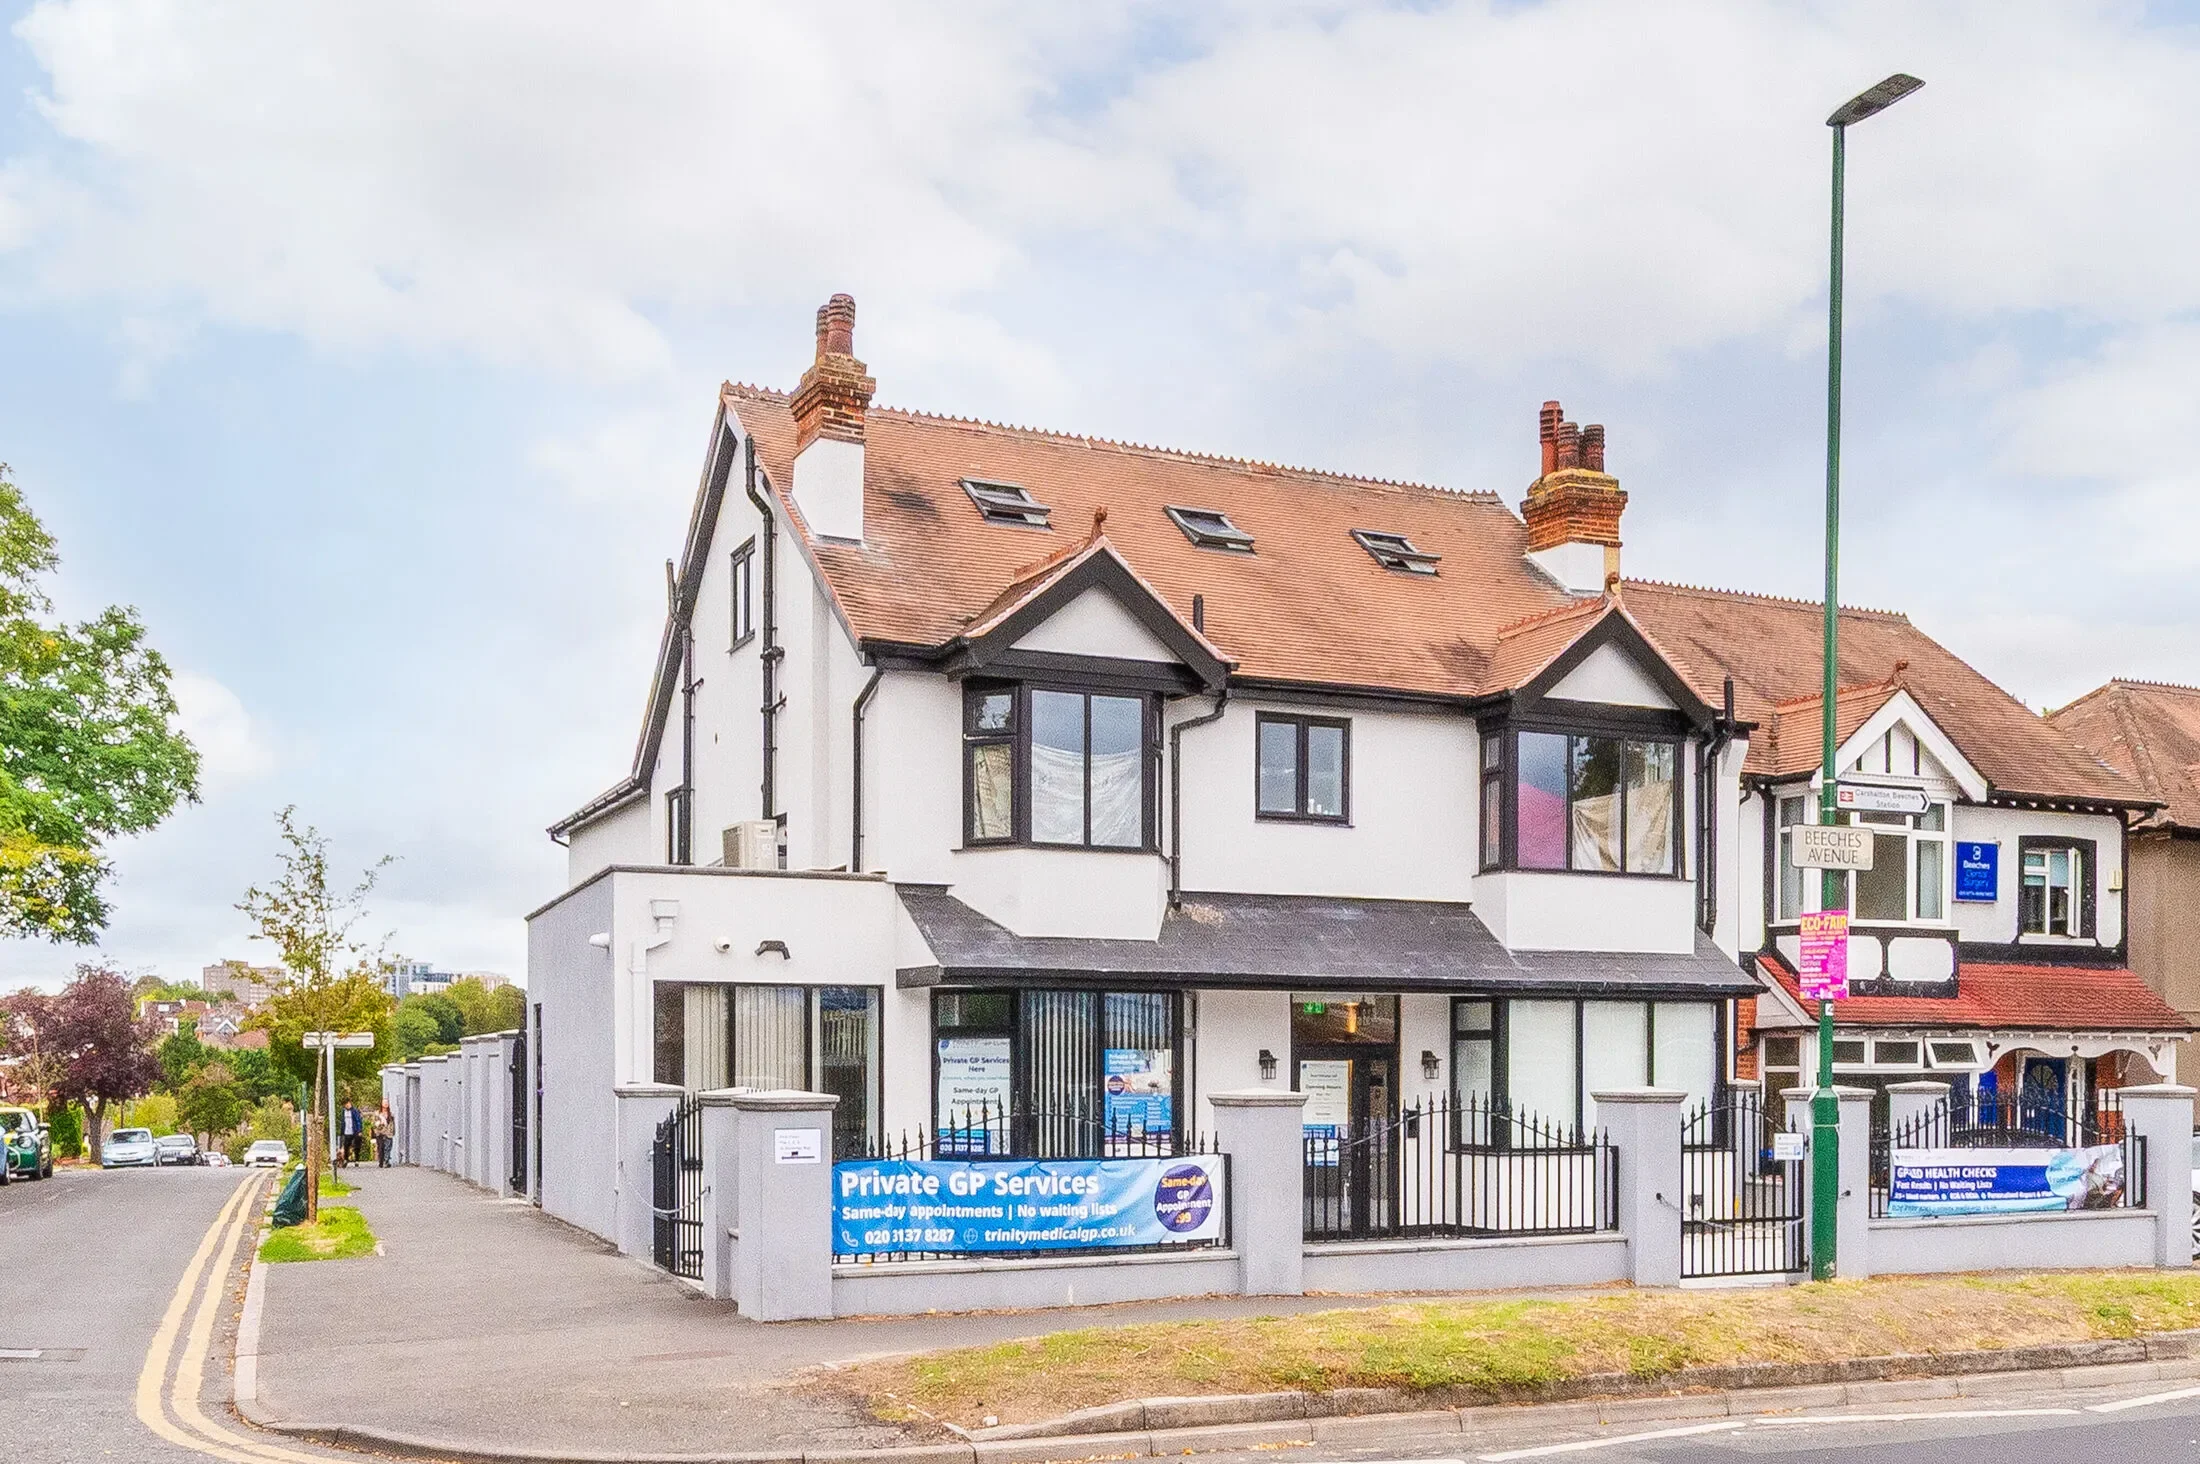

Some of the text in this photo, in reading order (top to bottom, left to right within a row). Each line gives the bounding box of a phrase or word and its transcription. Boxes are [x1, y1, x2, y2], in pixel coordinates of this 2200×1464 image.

[1855, 788, 1919, 801] Carshalton Beeches
[1876, 800, 1900, 809] Station
[1804, 830, 1862, 848] BEECHES
[1807, 848, 1859, 864] AVENUE
[1963, 860, 1990, 869] Beeches
[942, 1056, 1010, 1064] Private GP Services
[968, 1065, 986, 1073] Here
[953, 1086, 999, 1095] Same-day GP
[1925, 1167, 1960, 1179] HEALTH
[1961, 1167, 1998, 1178] CHECKS
[841, 1169, 1100, 1197] Private GP Services
[1161, 1174, 1209, 1188] Same-day
[1896, 1181, 1910, 1190] Fast
[1910, 1181, 1933, 1190] Results
[1939, 1181, 1949, 1190] No
[1949, 1181, 1976, 1191] Waiting
[1976, 1180, 1993, 1189] Lists
[1176, 1189, 1190, 1200] GP
[842, 1204, 907, 1221] Same-day
[910, 1203, 1004, 1220] appointments
[1017, 1203, 1037, 1218] No
[1040, 1201, 1088, 1219] waiting
[1091, 1201, 1118, 1216] lists
[864, 1224, 1136, 1245] 020 3137 8287 trinitymedicalgp.co.uk
